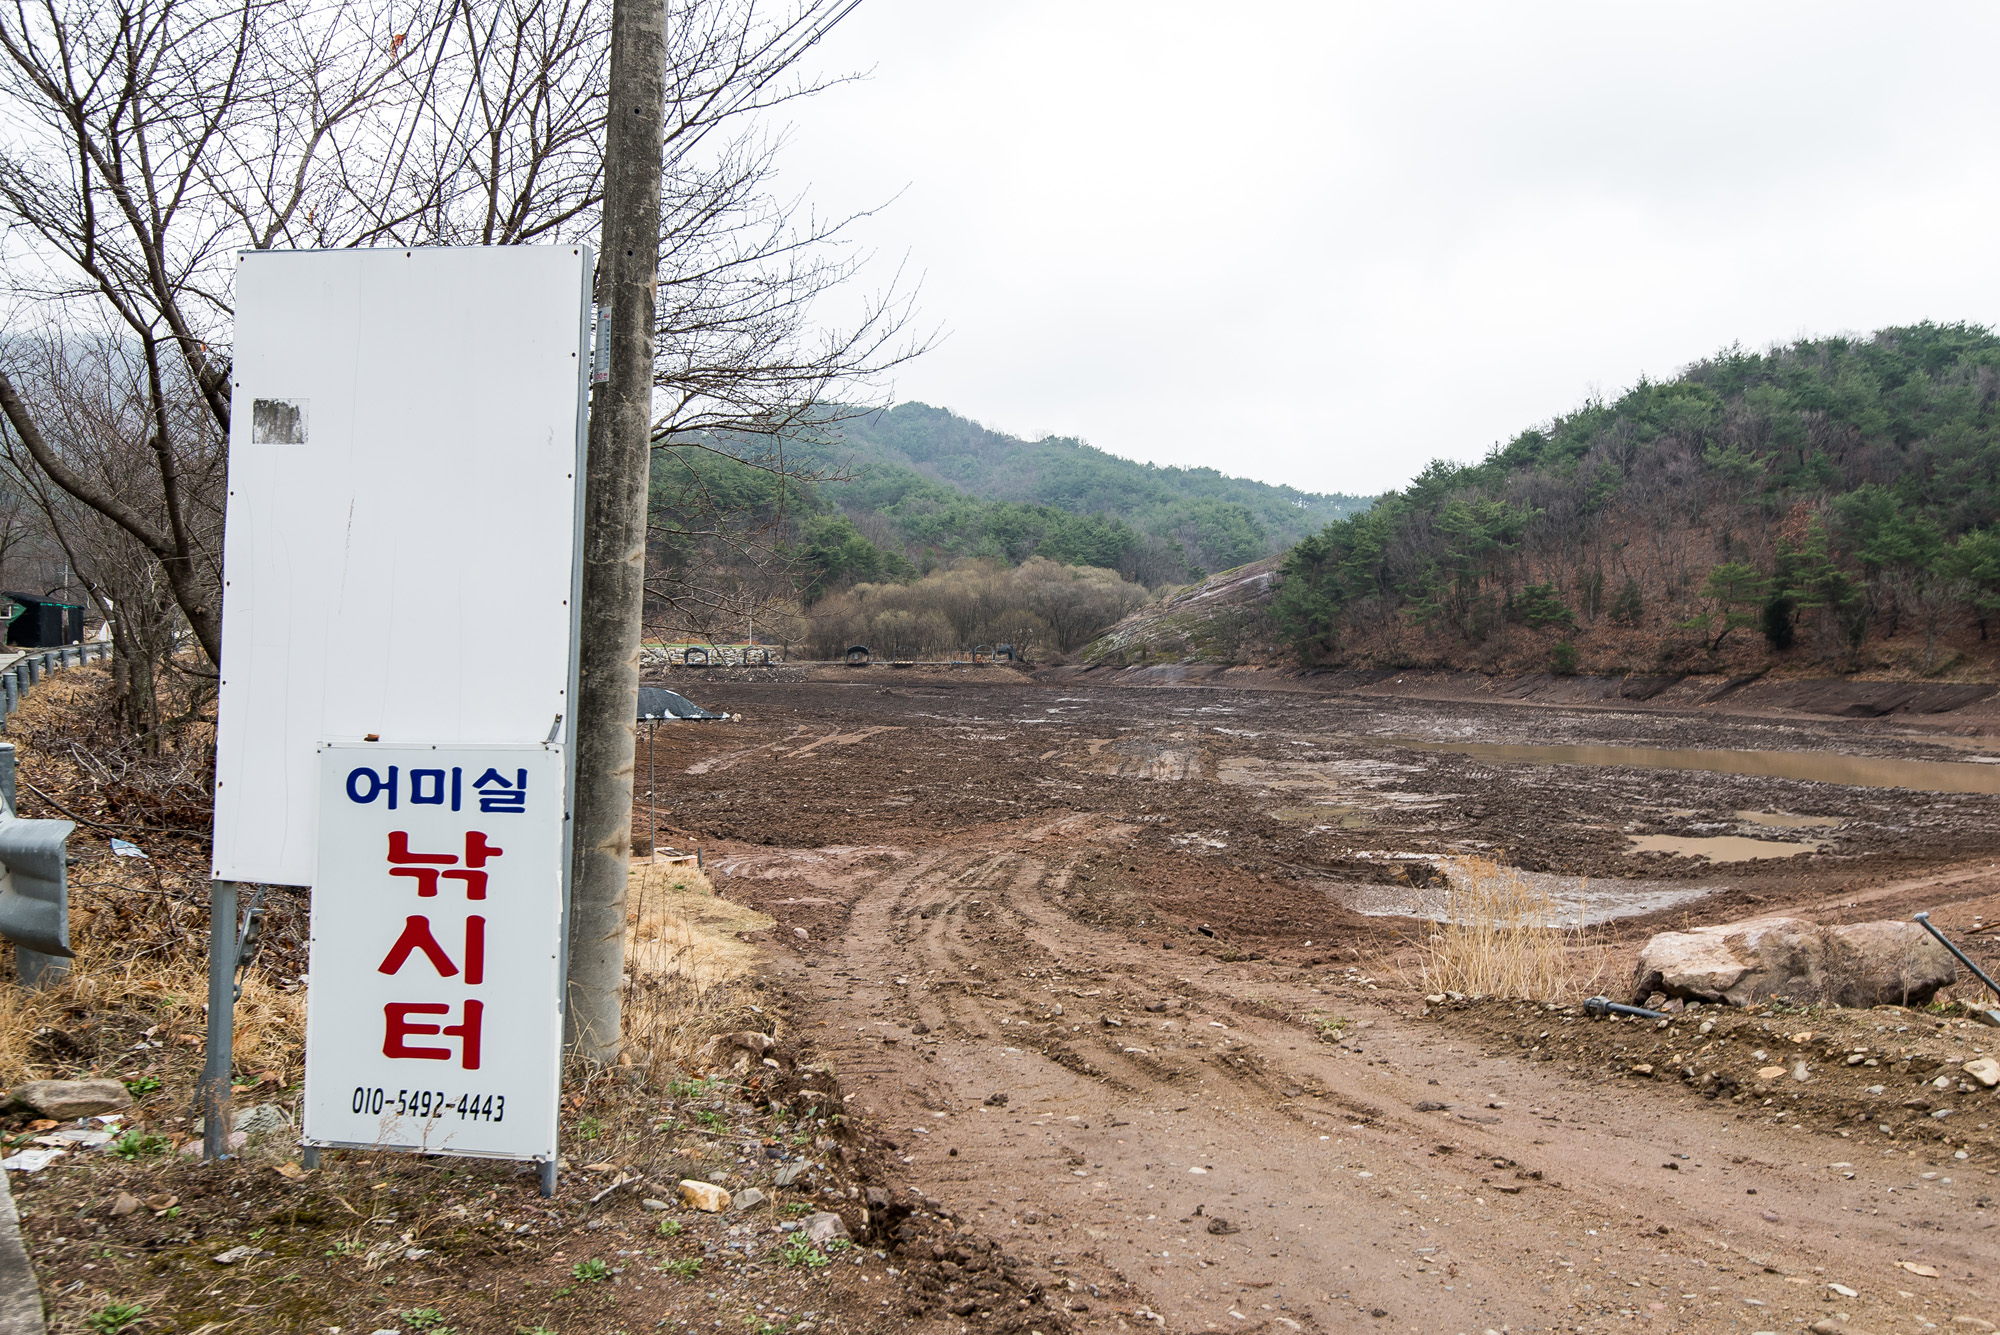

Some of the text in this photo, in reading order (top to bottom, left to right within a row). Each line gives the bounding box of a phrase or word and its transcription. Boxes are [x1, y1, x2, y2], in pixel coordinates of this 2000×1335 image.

[346, 765, 528, 814] 어미실
[378, 831, 503, 1070] 낚시터
[352, 1086, 505, 1122] 010-5492-4443
